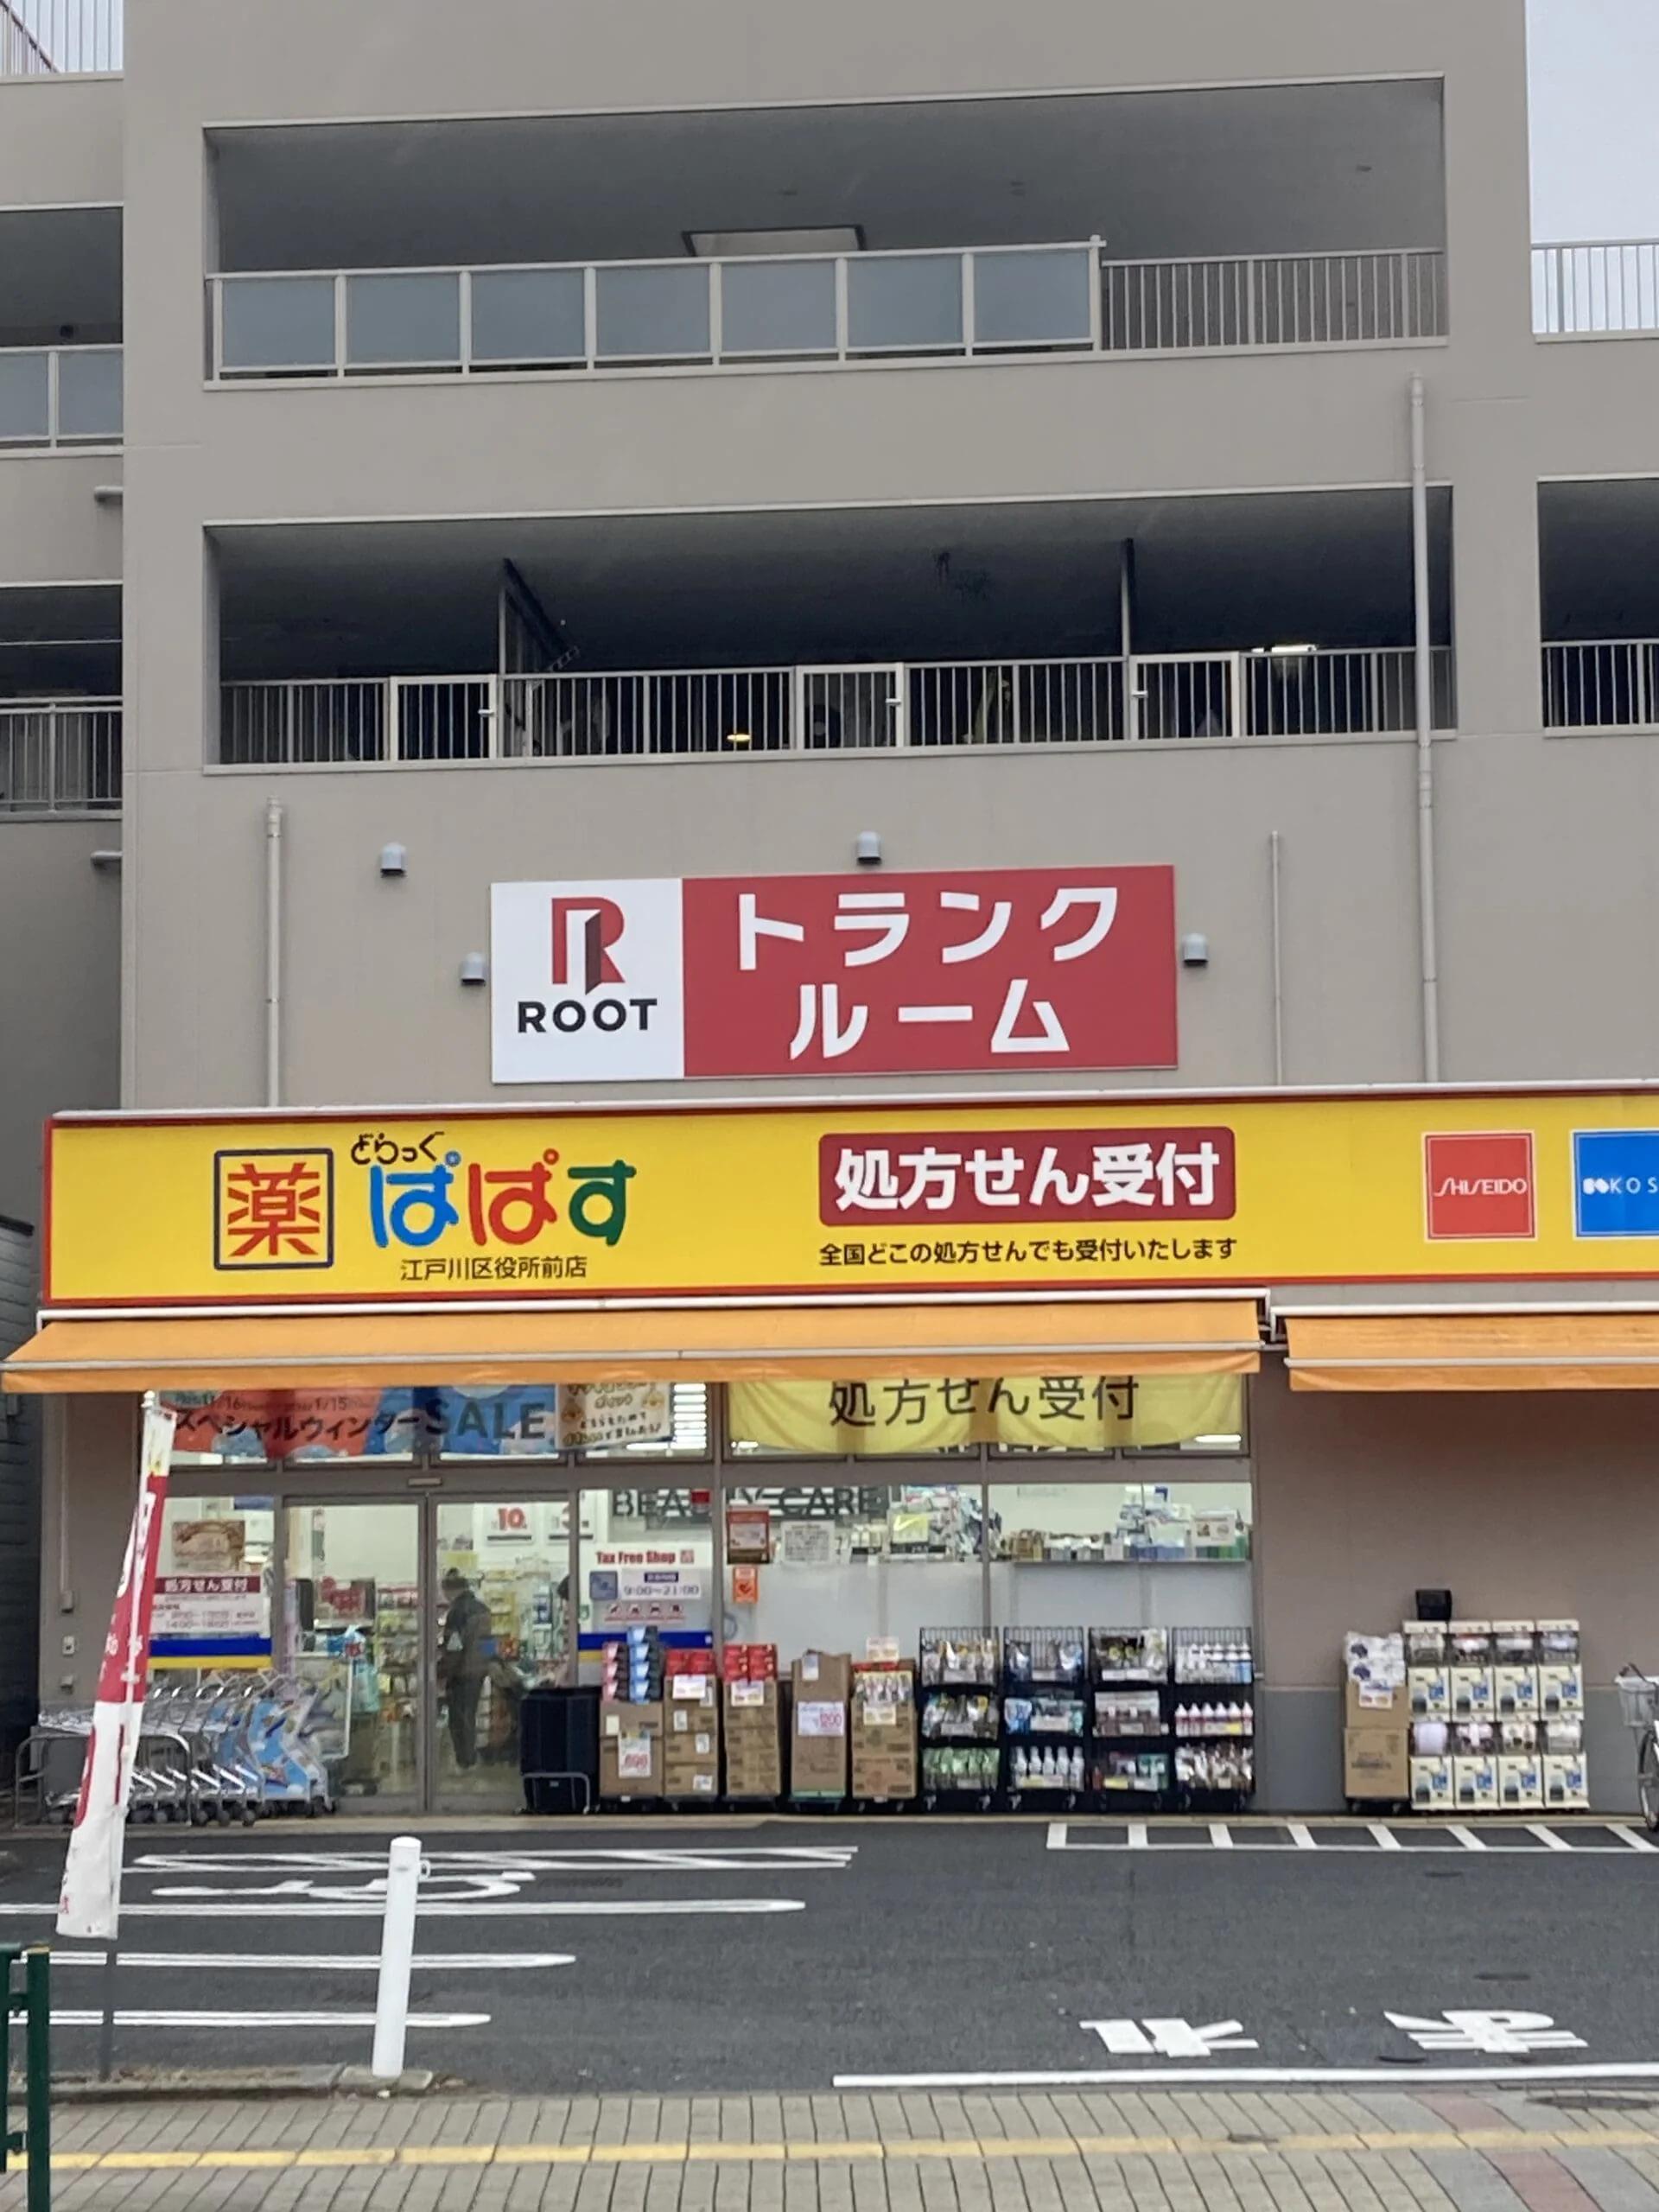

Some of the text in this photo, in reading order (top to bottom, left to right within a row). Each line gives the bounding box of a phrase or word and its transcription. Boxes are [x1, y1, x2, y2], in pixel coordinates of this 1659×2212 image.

[739, 887, 1118, 971] トランク
[518, 998, 658, 1034] ROOT
[789, 978, 1071, 1061] ルーム
[350, 1130, 445, 1166] どらっく
[369, 1147, 638, 1249] ぱぱす
[835, 1141, 1220, 1212] 処方せん受付
[1433, 1176, 1529, 1198] SHISEIDO
[226, 1162, 321, 1257] 薬
[400, 1255, 588, 1281] 江戸川区役所前店
[818, 1236, 1237, 1268] 全国どこの処方せんでも受付いたします
[827, 1375, 1140, 1427] 処方せん受付
